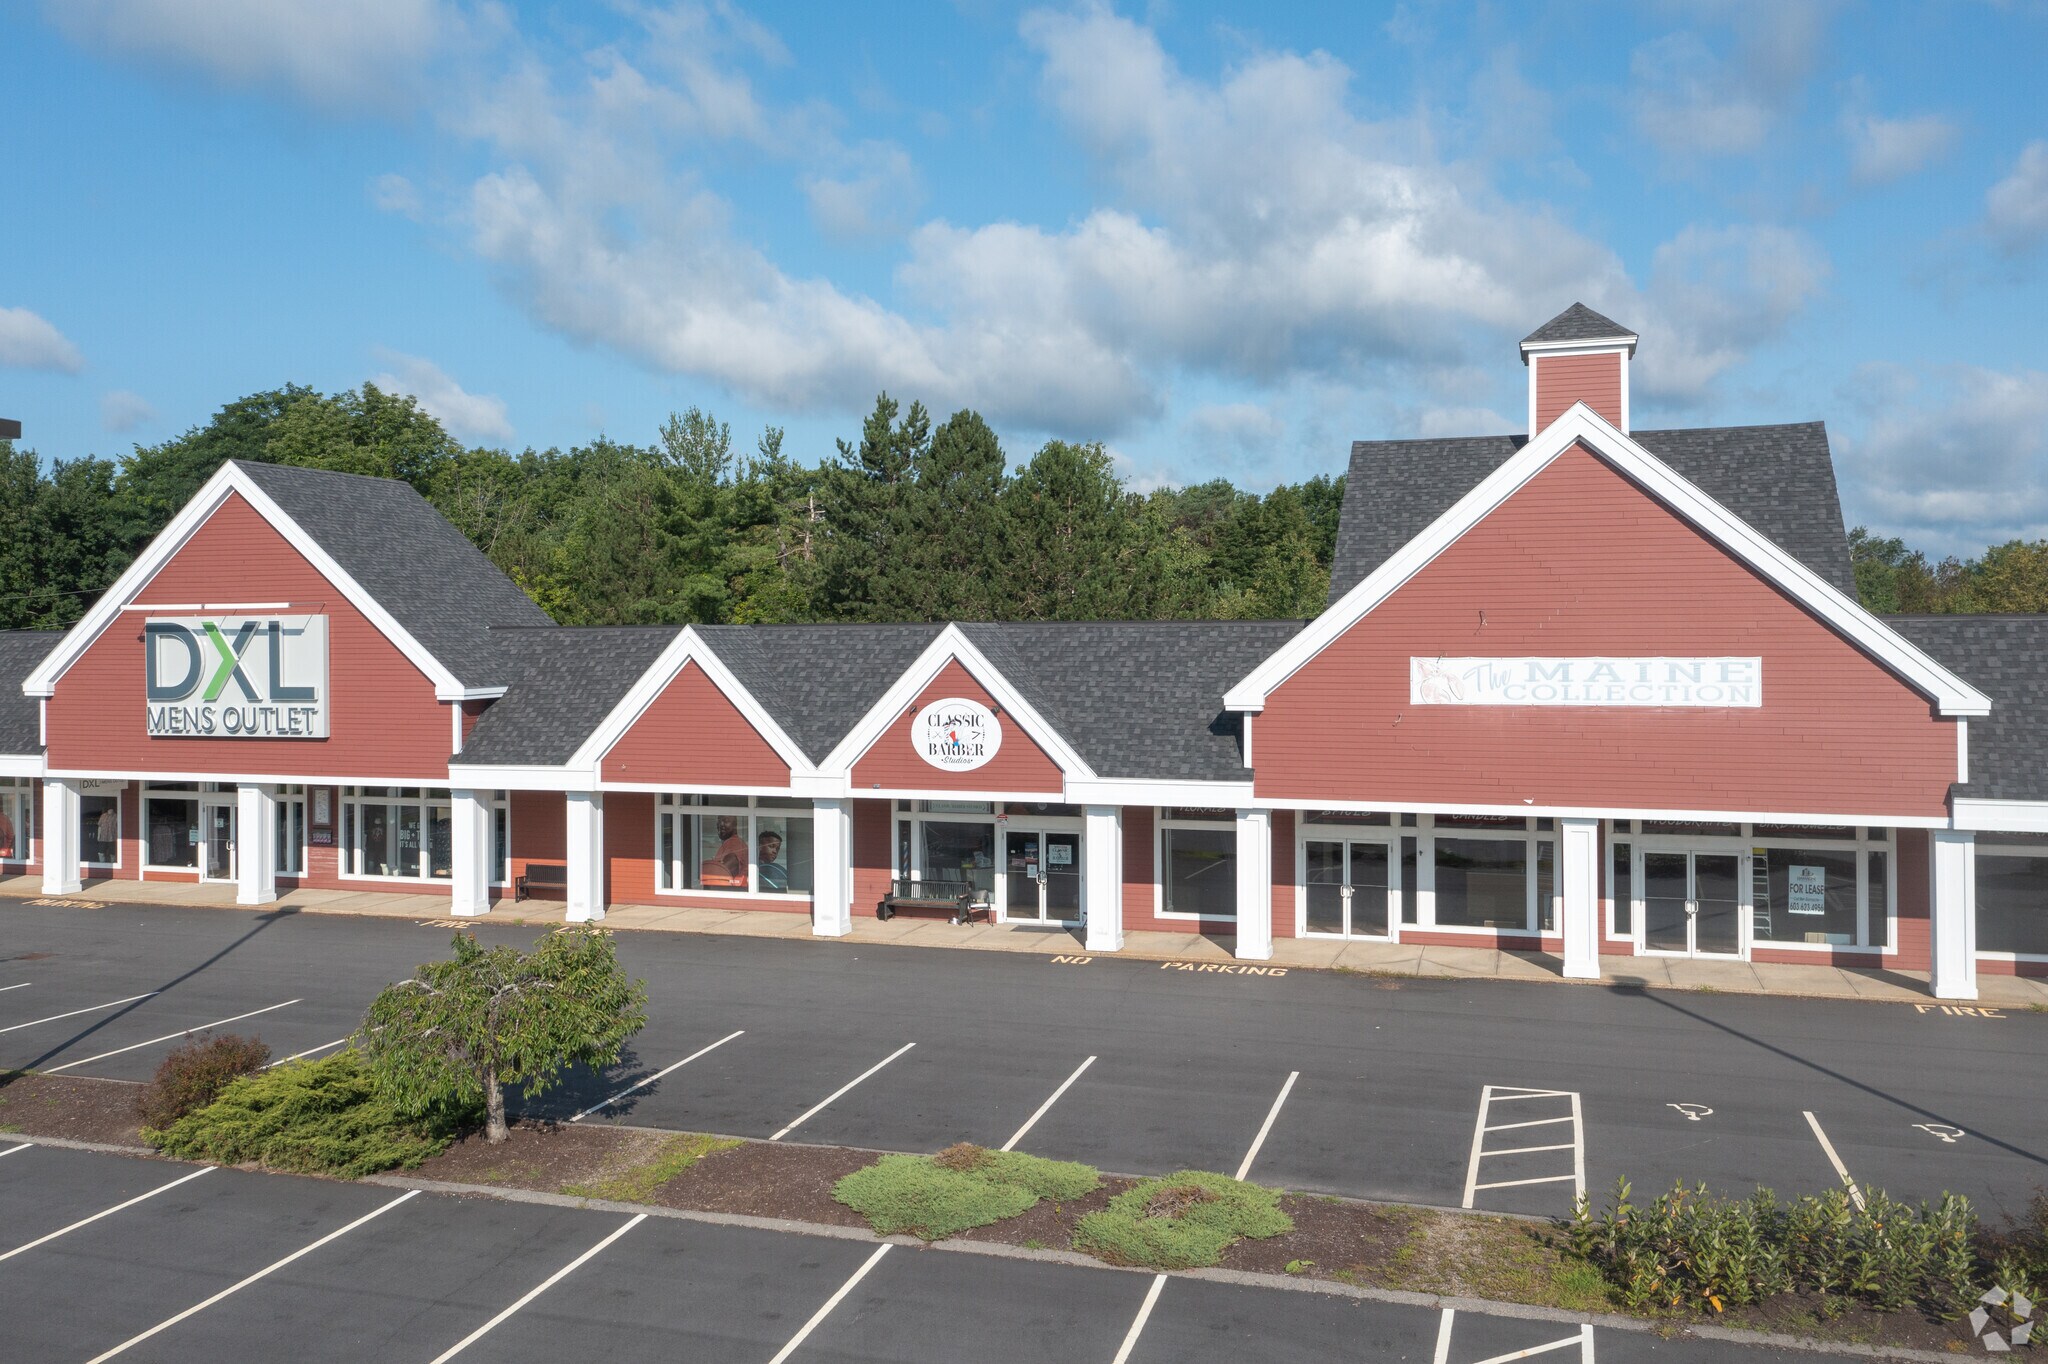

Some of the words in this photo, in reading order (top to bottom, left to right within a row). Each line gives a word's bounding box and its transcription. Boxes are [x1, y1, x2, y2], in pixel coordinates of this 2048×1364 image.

[146, 621, 316, 701] DXL
[1463, 662, 1511, 693] The
[1524, 661, 1753, 683] MAINE
[1503, 684, 1754, 702] COLLECTION
[147, 706, 215, 732] MENS
[223, 707, 316, 733] OUTLET
[928, 714, 984, 727] CLASSIC
[928, 743, 984, 756] BARBER
[943, 756, 971, 764] Studios
[82, 779, 100, 788] DXL
[1790, 883, 1803, 894] FOR
[1805, 884, 1824, 895] LEASE
[1051, 955, 1093, 965] NO
[1160, 962, 1288, 977] PARKING
[1914, 1004, 2007, 1018] FIRE
